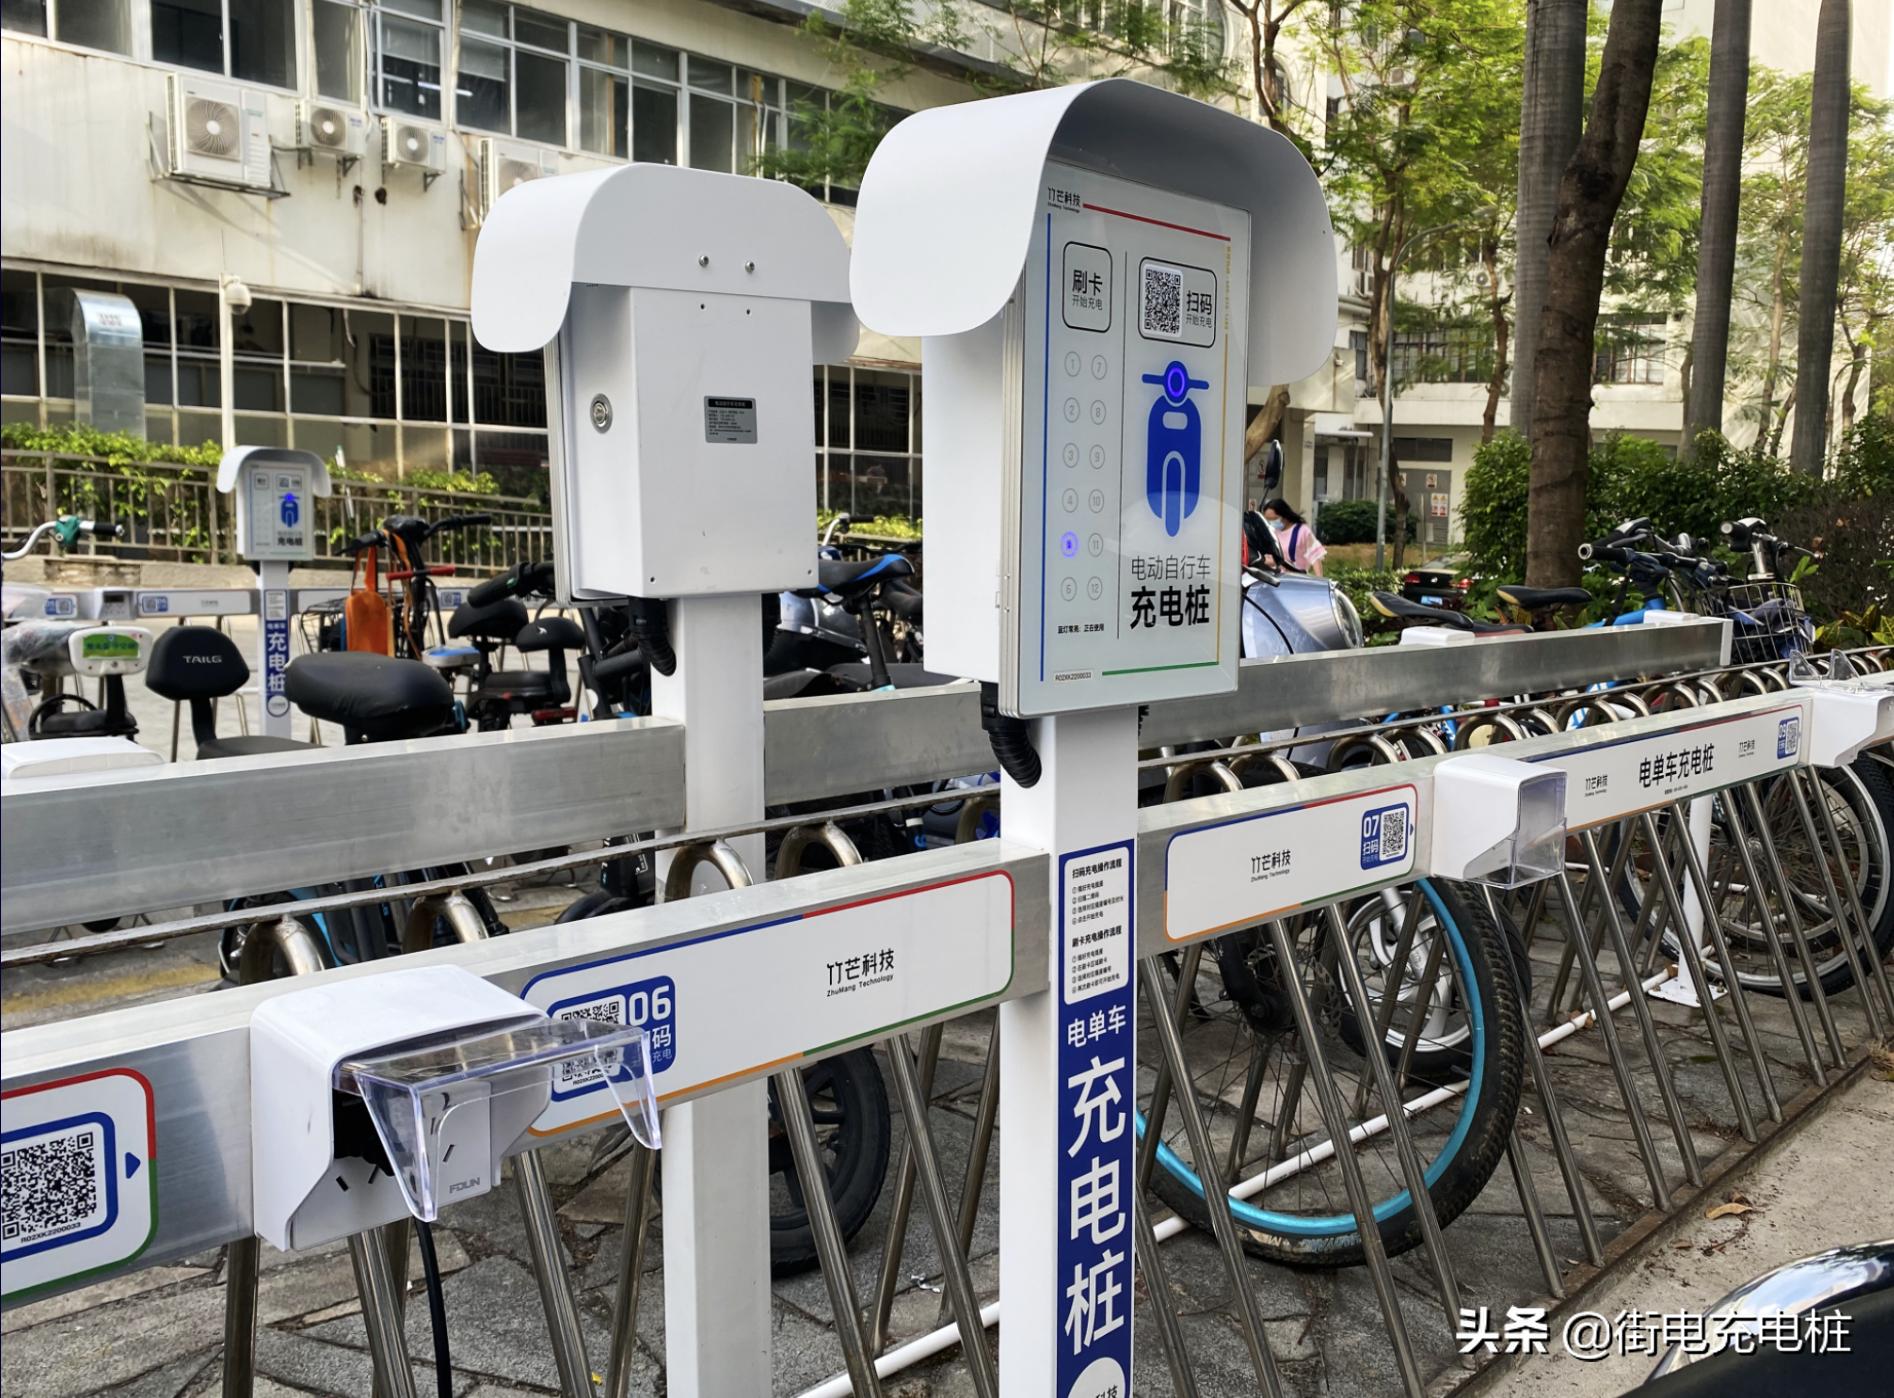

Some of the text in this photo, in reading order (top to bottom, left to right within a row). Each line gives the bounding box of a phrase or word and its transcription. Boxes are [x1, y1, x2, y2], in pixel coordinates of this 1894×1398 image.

[1072, 269, 1103, 296] 刷卡
[1072, 294, 1103, 311] 开始充电
[1186, 290, 1212, 316] 扫码
[1186, 313, 1212, 329] 开始充电
[1131, 554, 1211, 581] 电动自行车
[1130, 584, 1210, 629] 充电桩
[182, 655, 222, 664] TAILG
[1639, 743, 1715, 788] 电单车充电桩
[1363, 814, 1380, 838] 07
[1363, 839, 1379, 856] 扫码
[1251, 849, 1291, 874] 竹芒科技
[826, 948, 894, 986] 竹芒科技
[827, 974, 893, 997] ZhuMang Technology
[629, 985, 671, 1026] 06
[1067, 1004, 1127, 1048] 电单车
[1064, 1056, 1126, 1356] 充电桩
